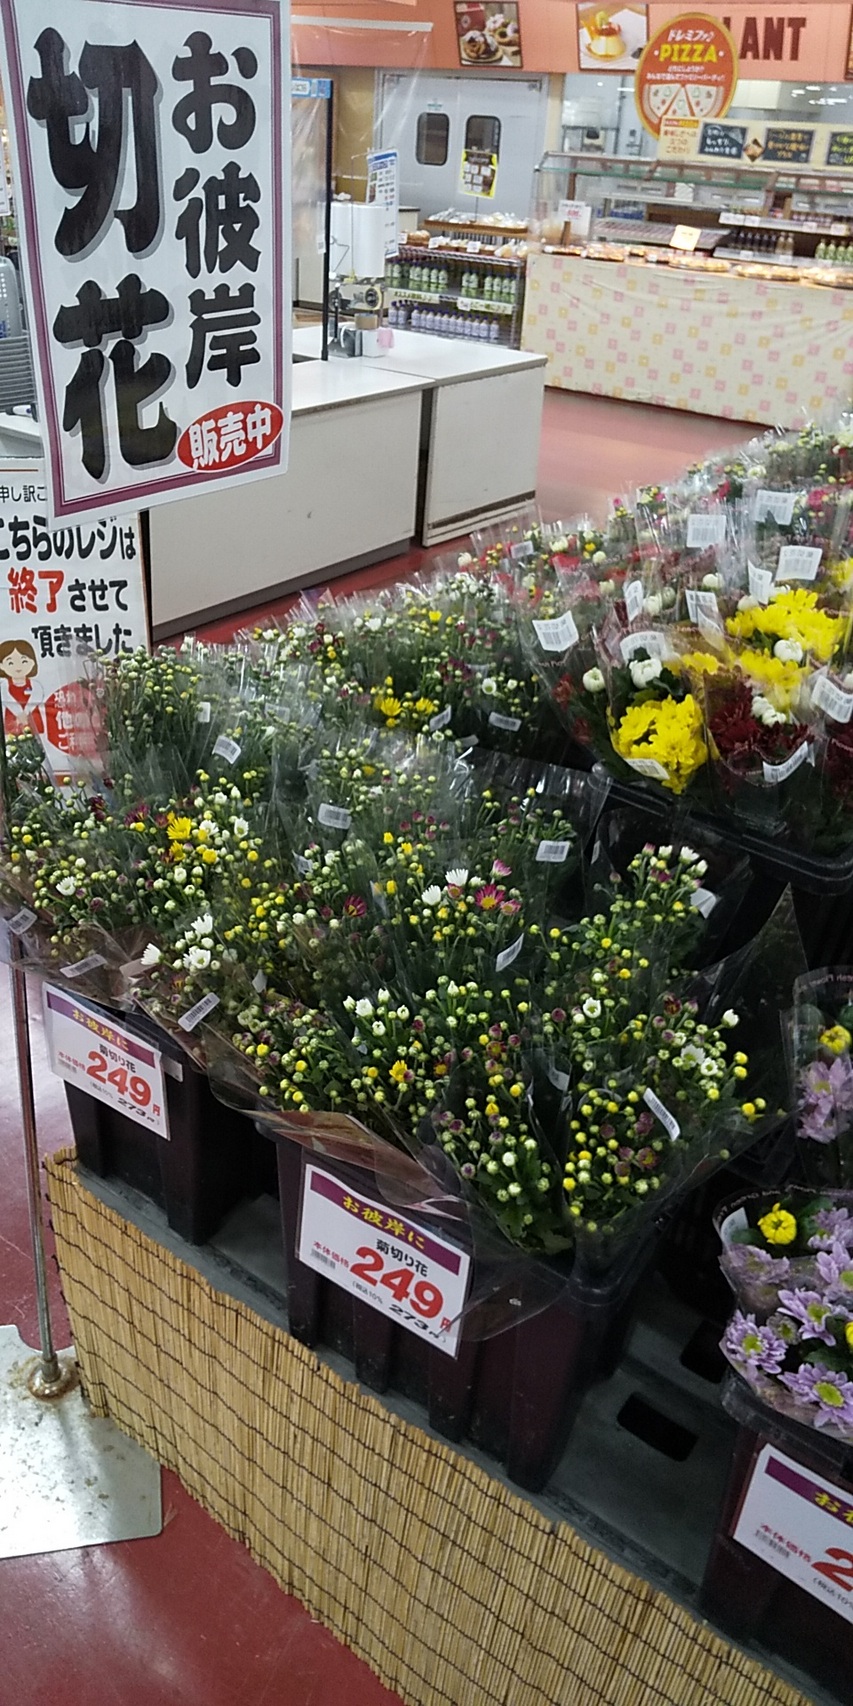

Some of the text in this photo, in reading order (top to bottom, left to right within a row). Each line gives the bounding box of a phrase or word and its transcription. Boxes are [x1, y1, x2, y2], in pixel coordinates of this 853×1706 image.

[659, 43, 718, 62] PIZZA
[722, 16, 807, 61] ANT
[171, 31, 261, 389] お彼岸
[27, 27, 178, 485] 切花
[189, 402, 272, 469] 販売中
[32, 622, 134, 659] 頂きました
[72, 1009, 129, 1051] お彼岸に
[343, 1195, 426, 1250] お彼岸に
[313, 1241, 349, 1269] 本体価格
[376, 1237, 428, 1278] 菊切り花
